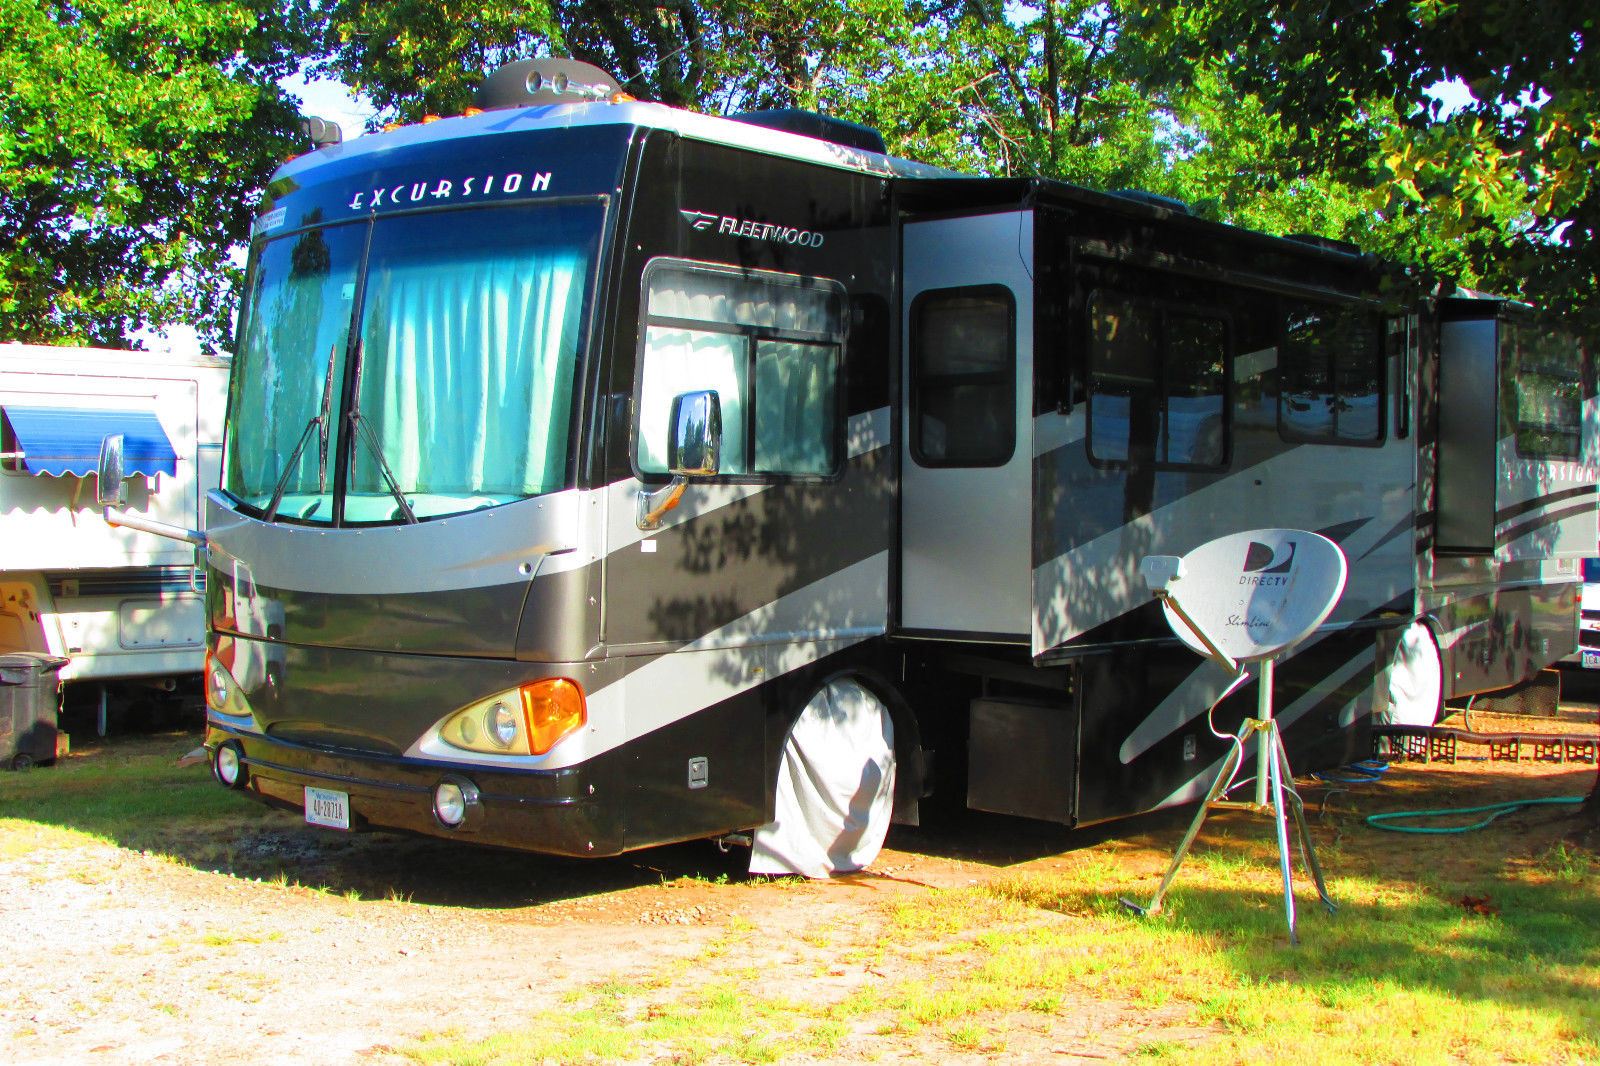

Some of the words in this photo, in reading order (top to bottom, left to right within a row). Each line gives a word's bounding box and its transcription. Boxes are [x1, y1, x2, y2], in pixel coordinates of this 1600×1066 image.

[349, 172, 552, 209] EXCURSION
[719, 216, 824, 248] FLEETWOOD
[1239, 576, 1288, 586] DIRECTV
